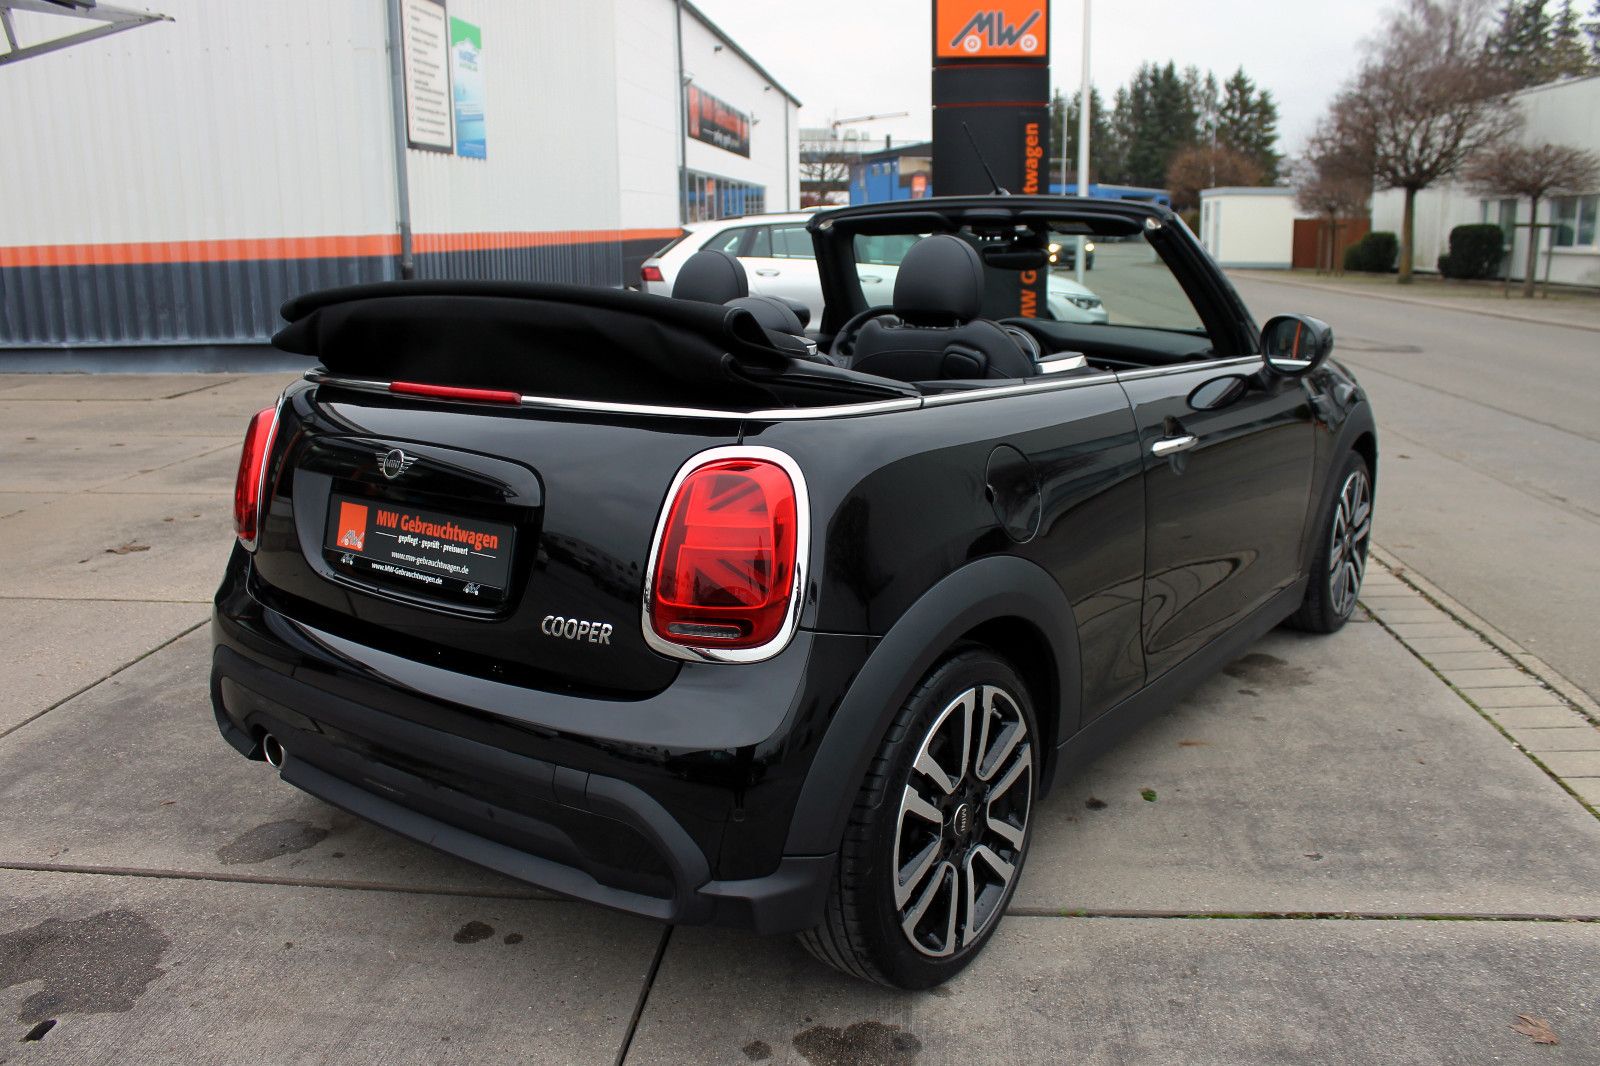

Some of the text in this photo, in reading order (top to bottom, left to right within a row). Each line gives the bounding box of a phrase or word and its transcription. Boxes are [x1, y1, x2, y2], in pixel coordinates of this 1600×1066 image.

[950, 9, 1042, 50] MW
[376, 510, 498, 551] MW Gebrauchtwagen
[398, 534, 468, 556] gepflegt geprüft preiswert
[371, 562, 443, 585] www.MW-Gebrauchtwagen.de
[391, 551, 469, 575] www.mw-gebrauchtwagen.de
[541, 615, 613, 645] COOPER
